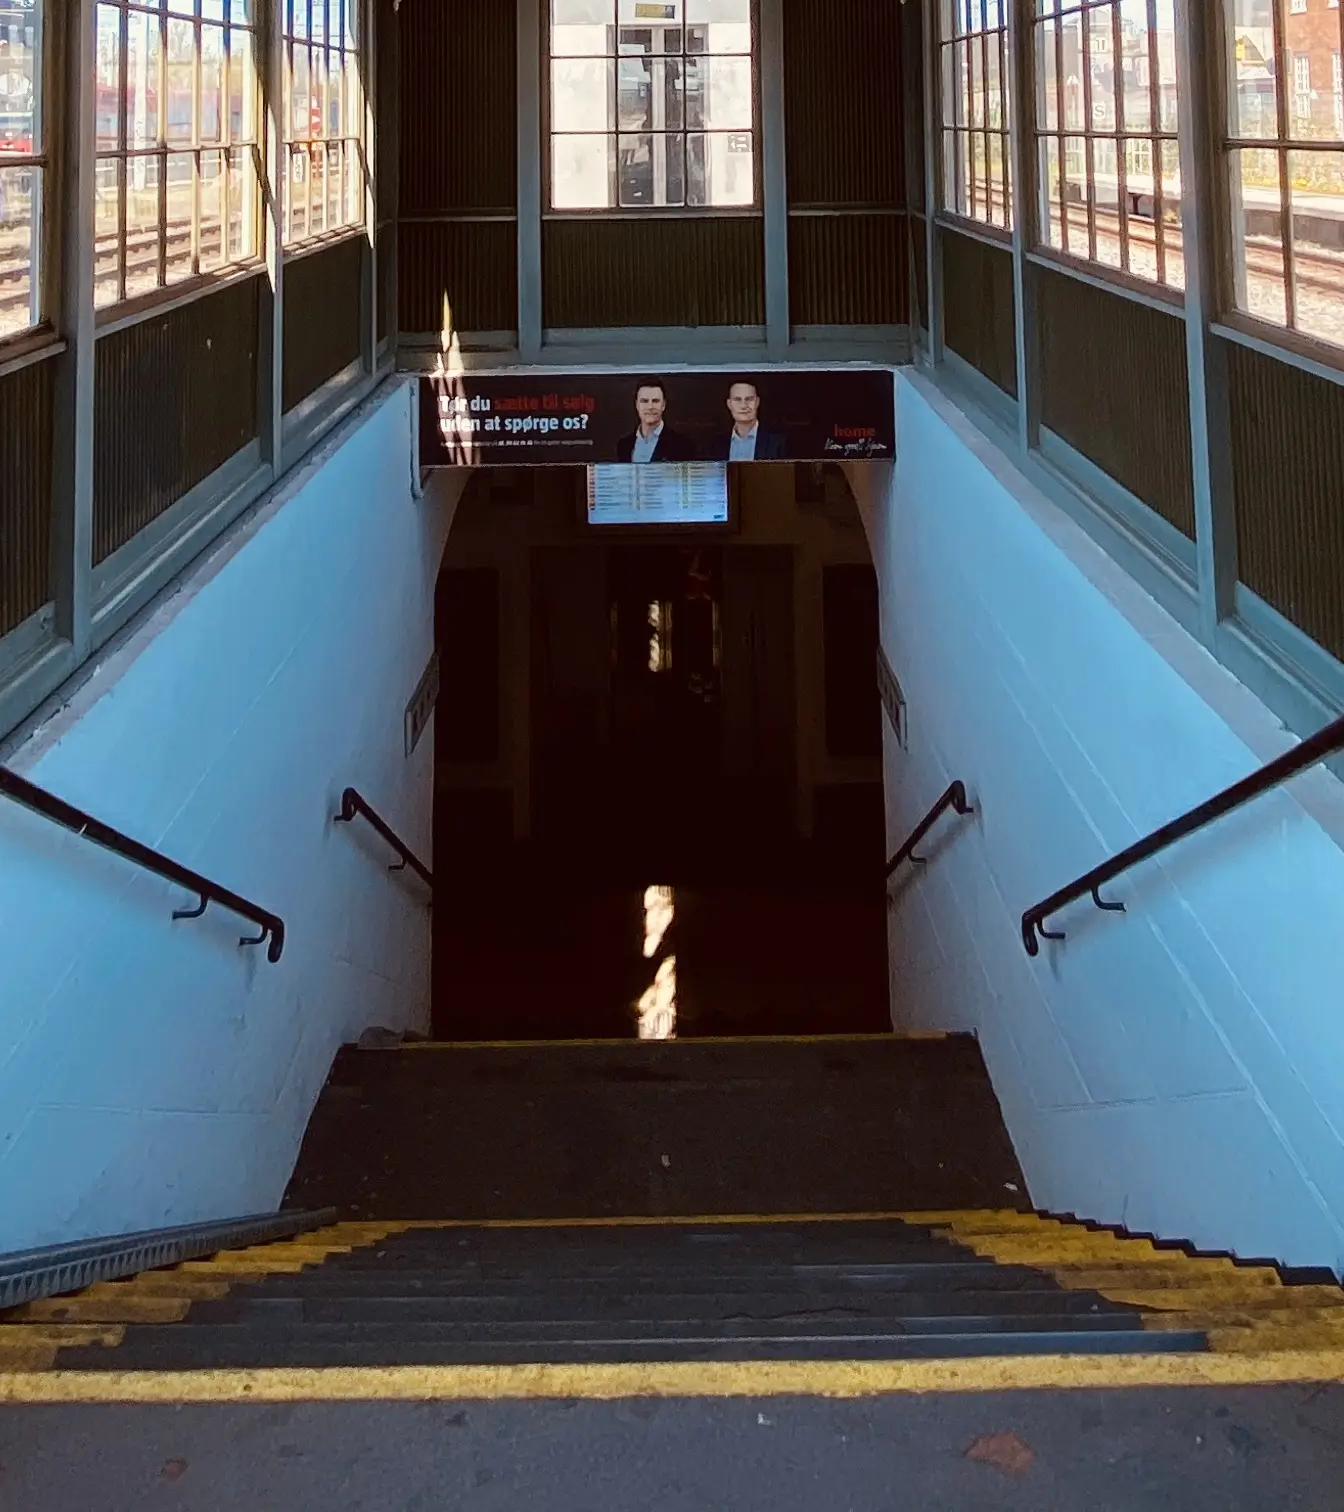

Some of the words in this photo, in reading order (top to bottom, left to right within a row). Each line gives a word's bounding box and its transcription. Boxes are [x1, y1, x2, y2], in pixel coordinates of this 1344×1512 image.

[1094, 104, 1105, 117] S
[470, 395, 491, 411] du
[542, 394, 558, 410] til
[440, 414, 481, 432] uden
[484, 415, 501, 431] at
[504, 416, 559, 434] spørge
[562, 414, 589, 430] os?
